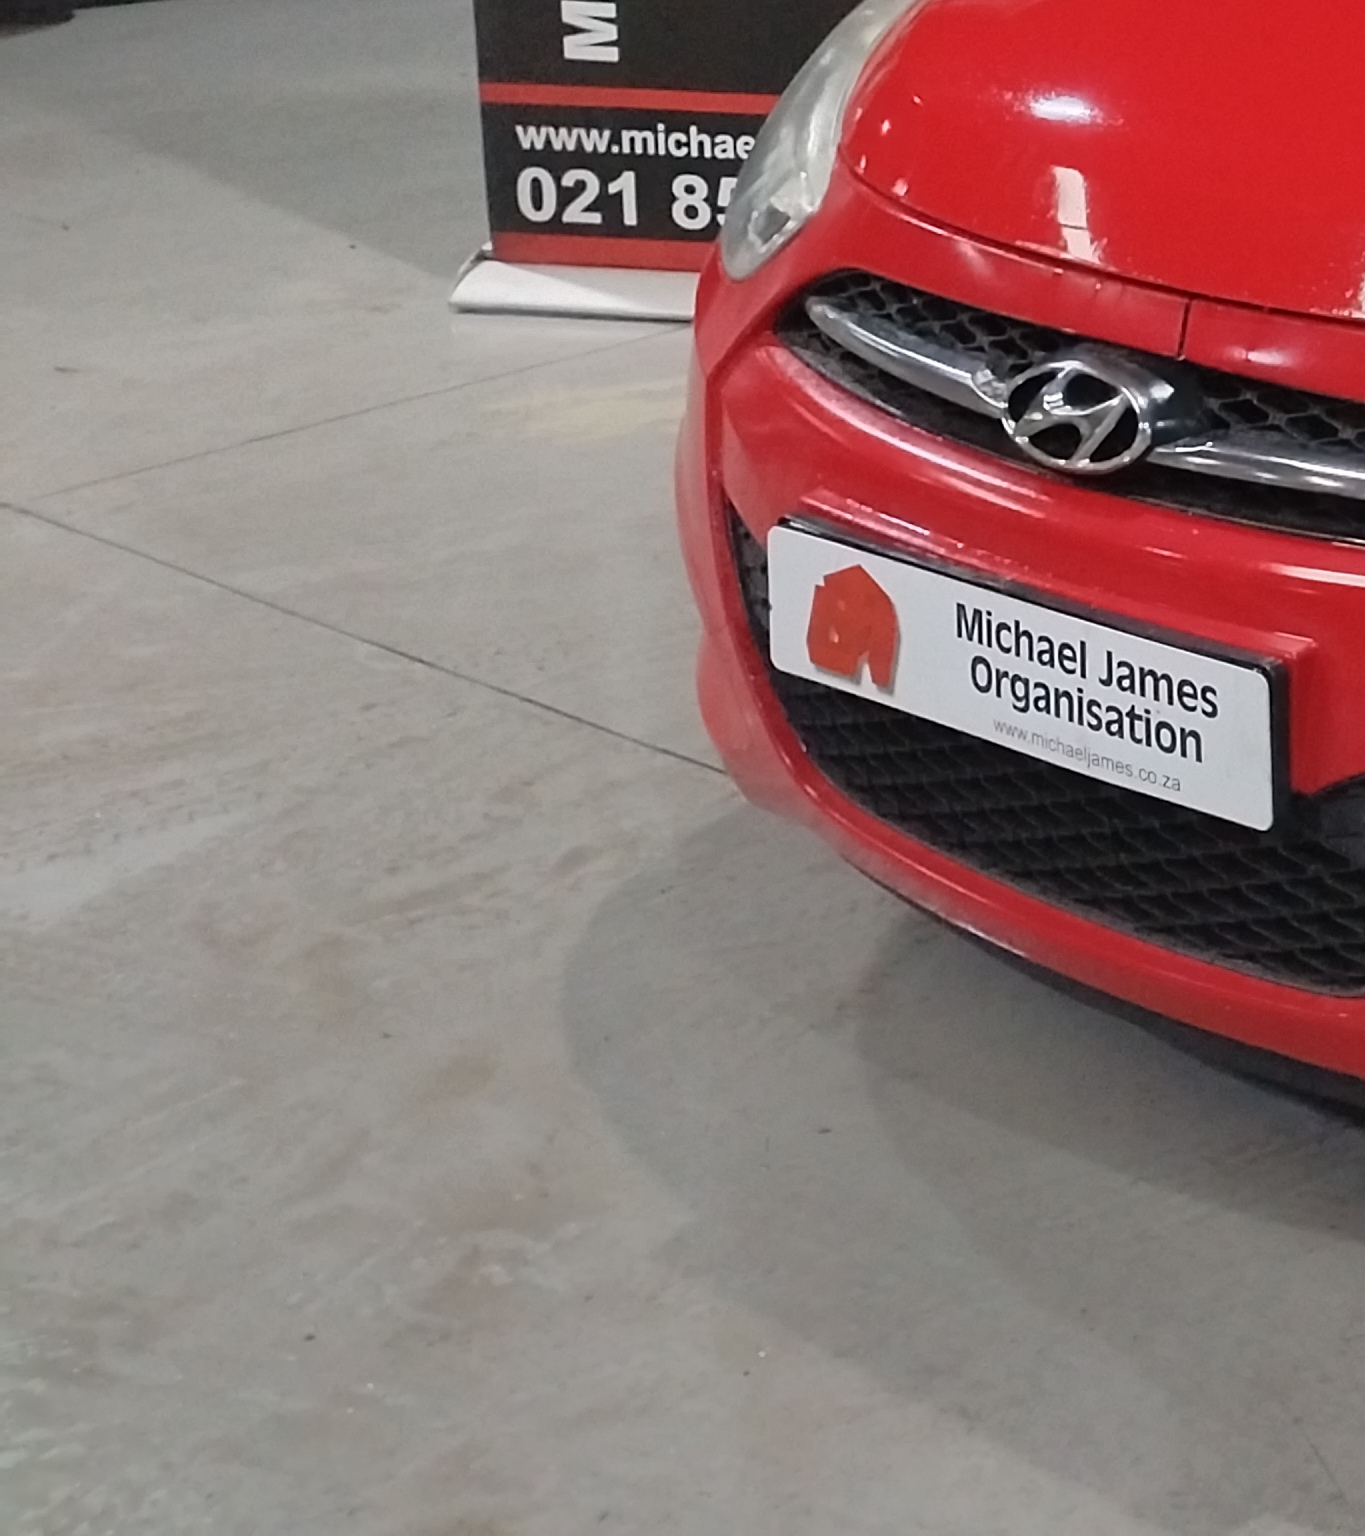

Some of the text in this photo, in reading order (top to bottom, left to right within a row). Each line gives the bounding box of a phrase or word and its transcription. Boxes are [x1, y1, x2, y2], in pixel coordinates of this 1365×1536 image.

[516, 166, 637, 226] 021
[956, 602, 1219, 719] Michael James
[970, 655, 1203, 763] Organisation
[992, 719, 1182, 791] www.michaeljames.co.za
